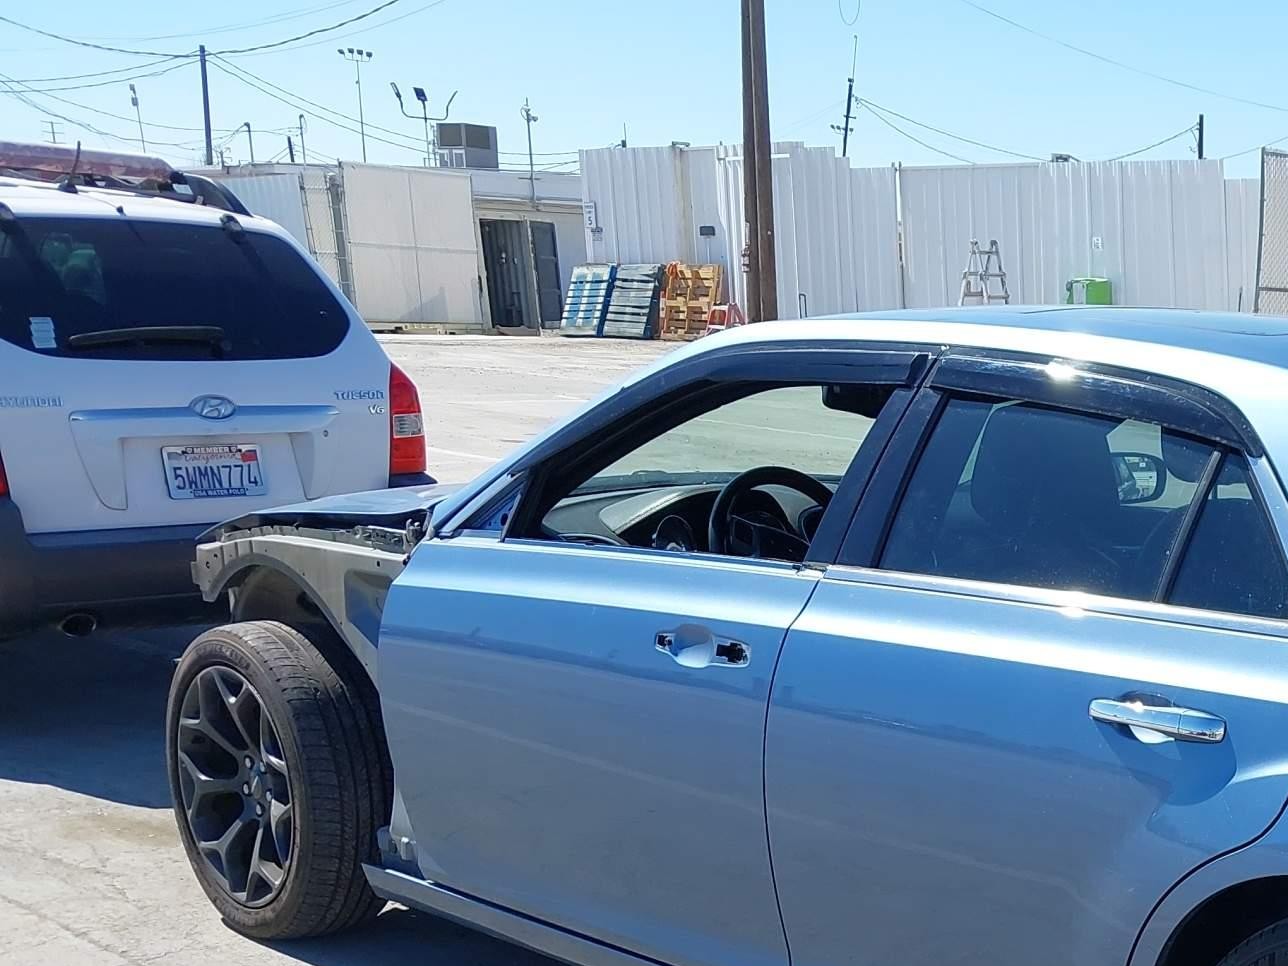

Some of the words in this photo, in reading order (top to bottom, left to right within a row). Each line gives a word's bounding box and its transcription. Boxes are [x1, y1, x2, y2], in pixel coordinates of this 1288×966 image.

[368, 404, 385, 415] V6
[193, 446, 230, 454] MEMBER
[173, 464, 259, 490] 5WMN774
